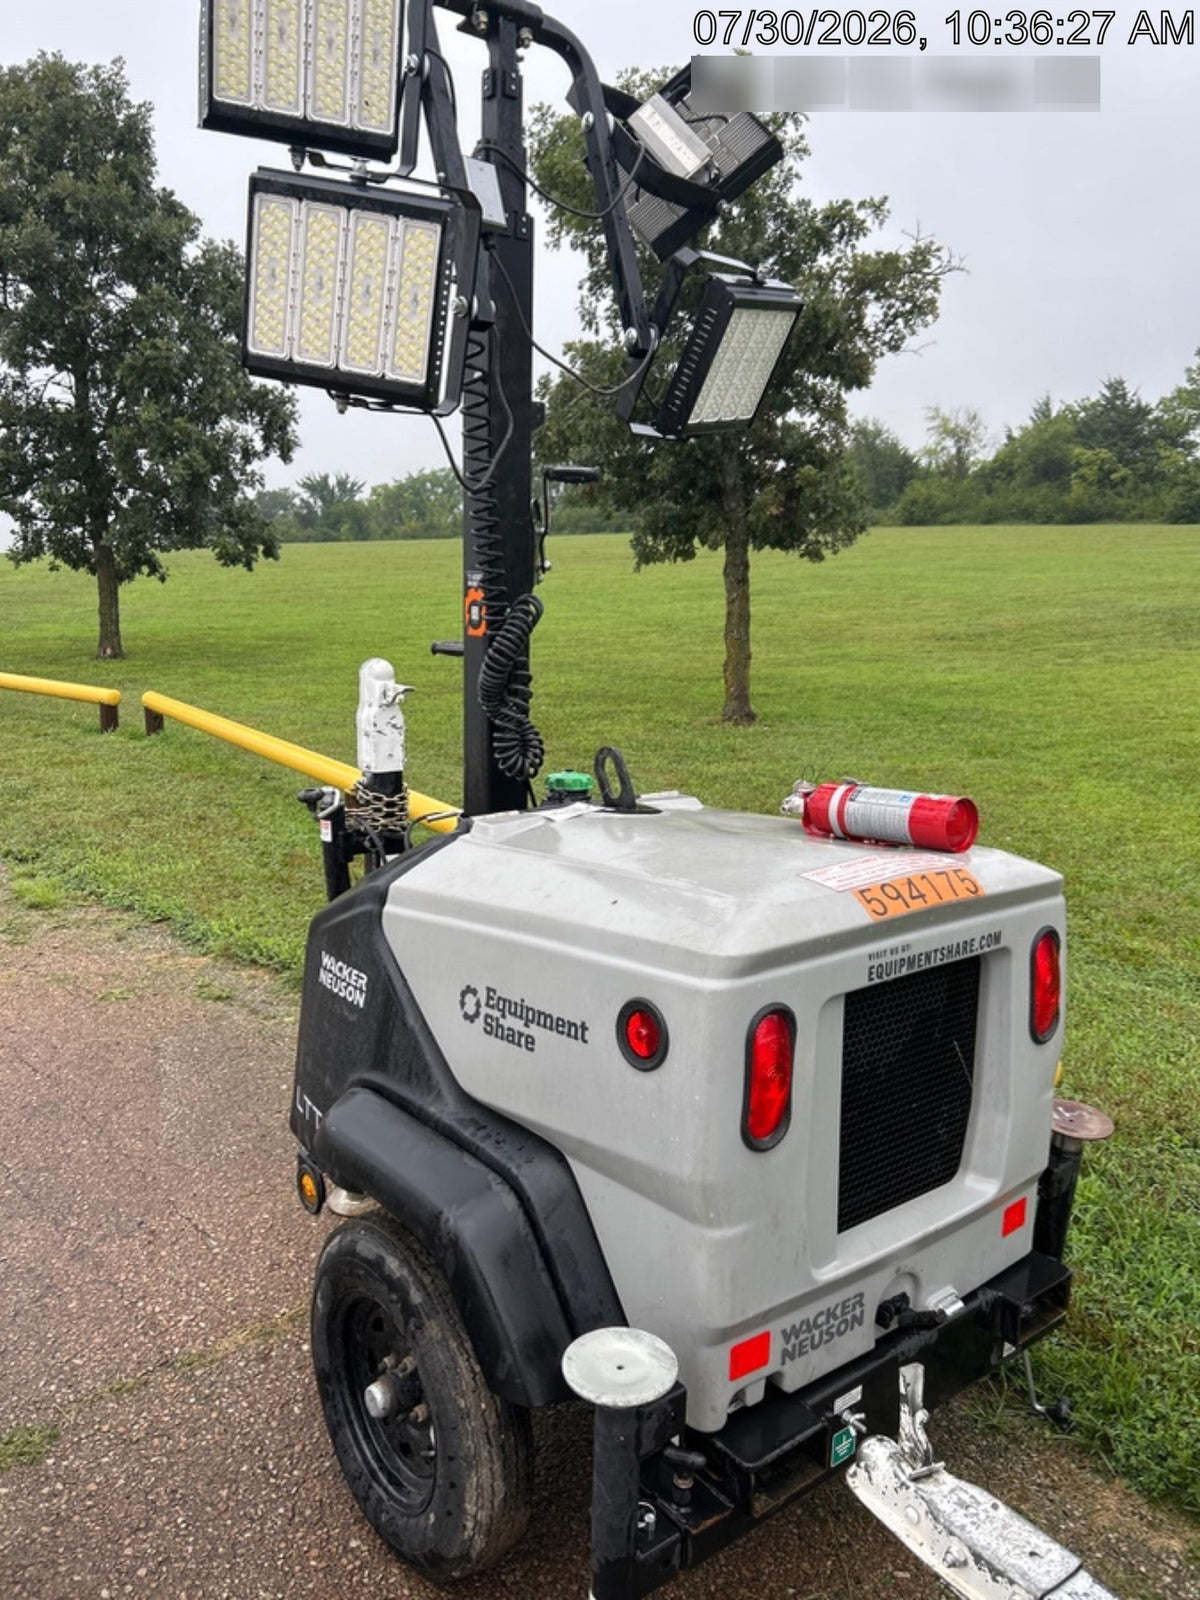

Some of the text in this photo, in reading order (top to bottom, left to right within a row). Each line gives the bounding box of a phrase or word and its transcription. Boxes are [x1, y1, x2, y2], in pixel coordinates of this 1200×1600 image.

[858, 868, 979, 917] 594175
[321, 950, 368, 991] WACKER
[867, 930, 1002, 982] EQUIPMENTSHARE.COM
[319, 967, 366, 1009] NEUSON
[483, 1013, 536, 1053] Share
[484, 986, 589, 1044] Equipment
[781, 1292, 865, 1345] WACKER
[781, 1309, 864, 1367] NEUSON
